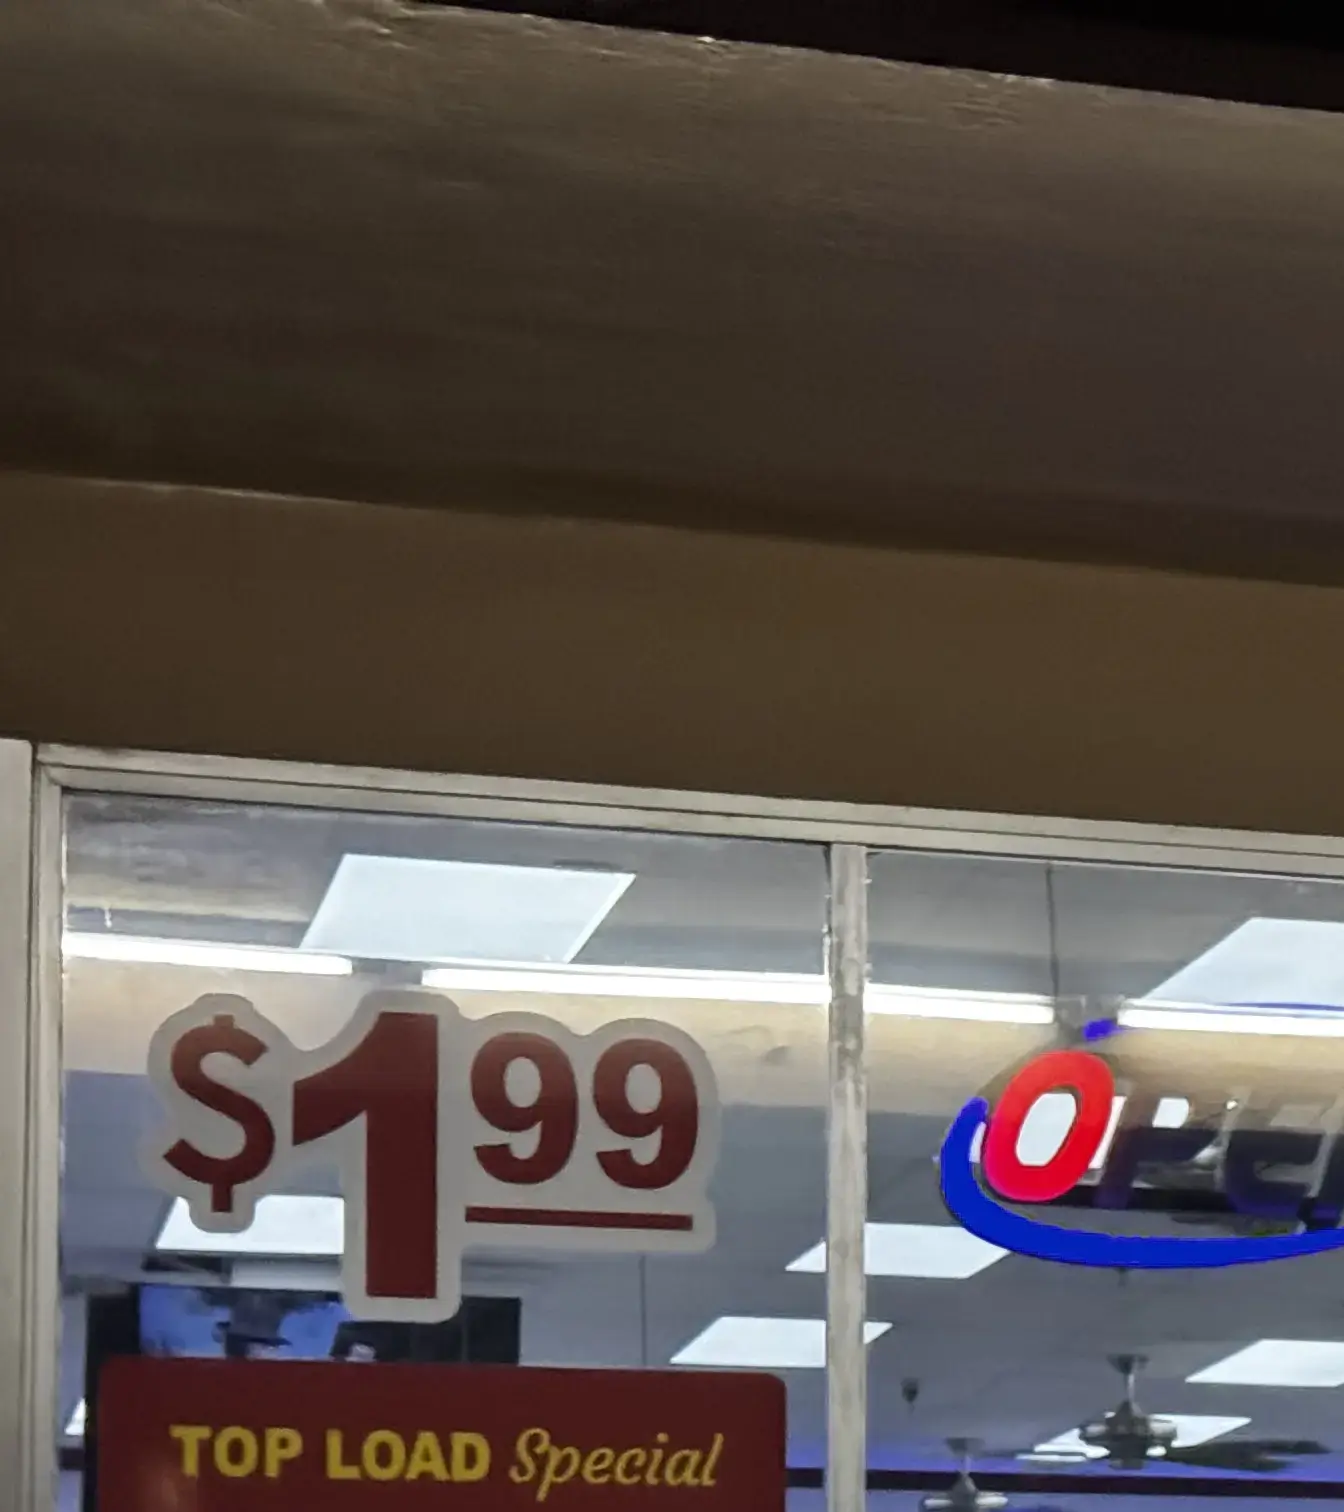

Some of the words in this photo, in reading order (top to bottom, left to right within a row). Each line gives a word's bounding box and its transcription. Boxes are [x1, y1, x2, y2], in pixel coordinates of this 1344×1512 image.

[170, 1425, 301, 1481] TOP
[325, 1430, 490, 1483] LOAD
[508, 1428, 724, 1500] Special
